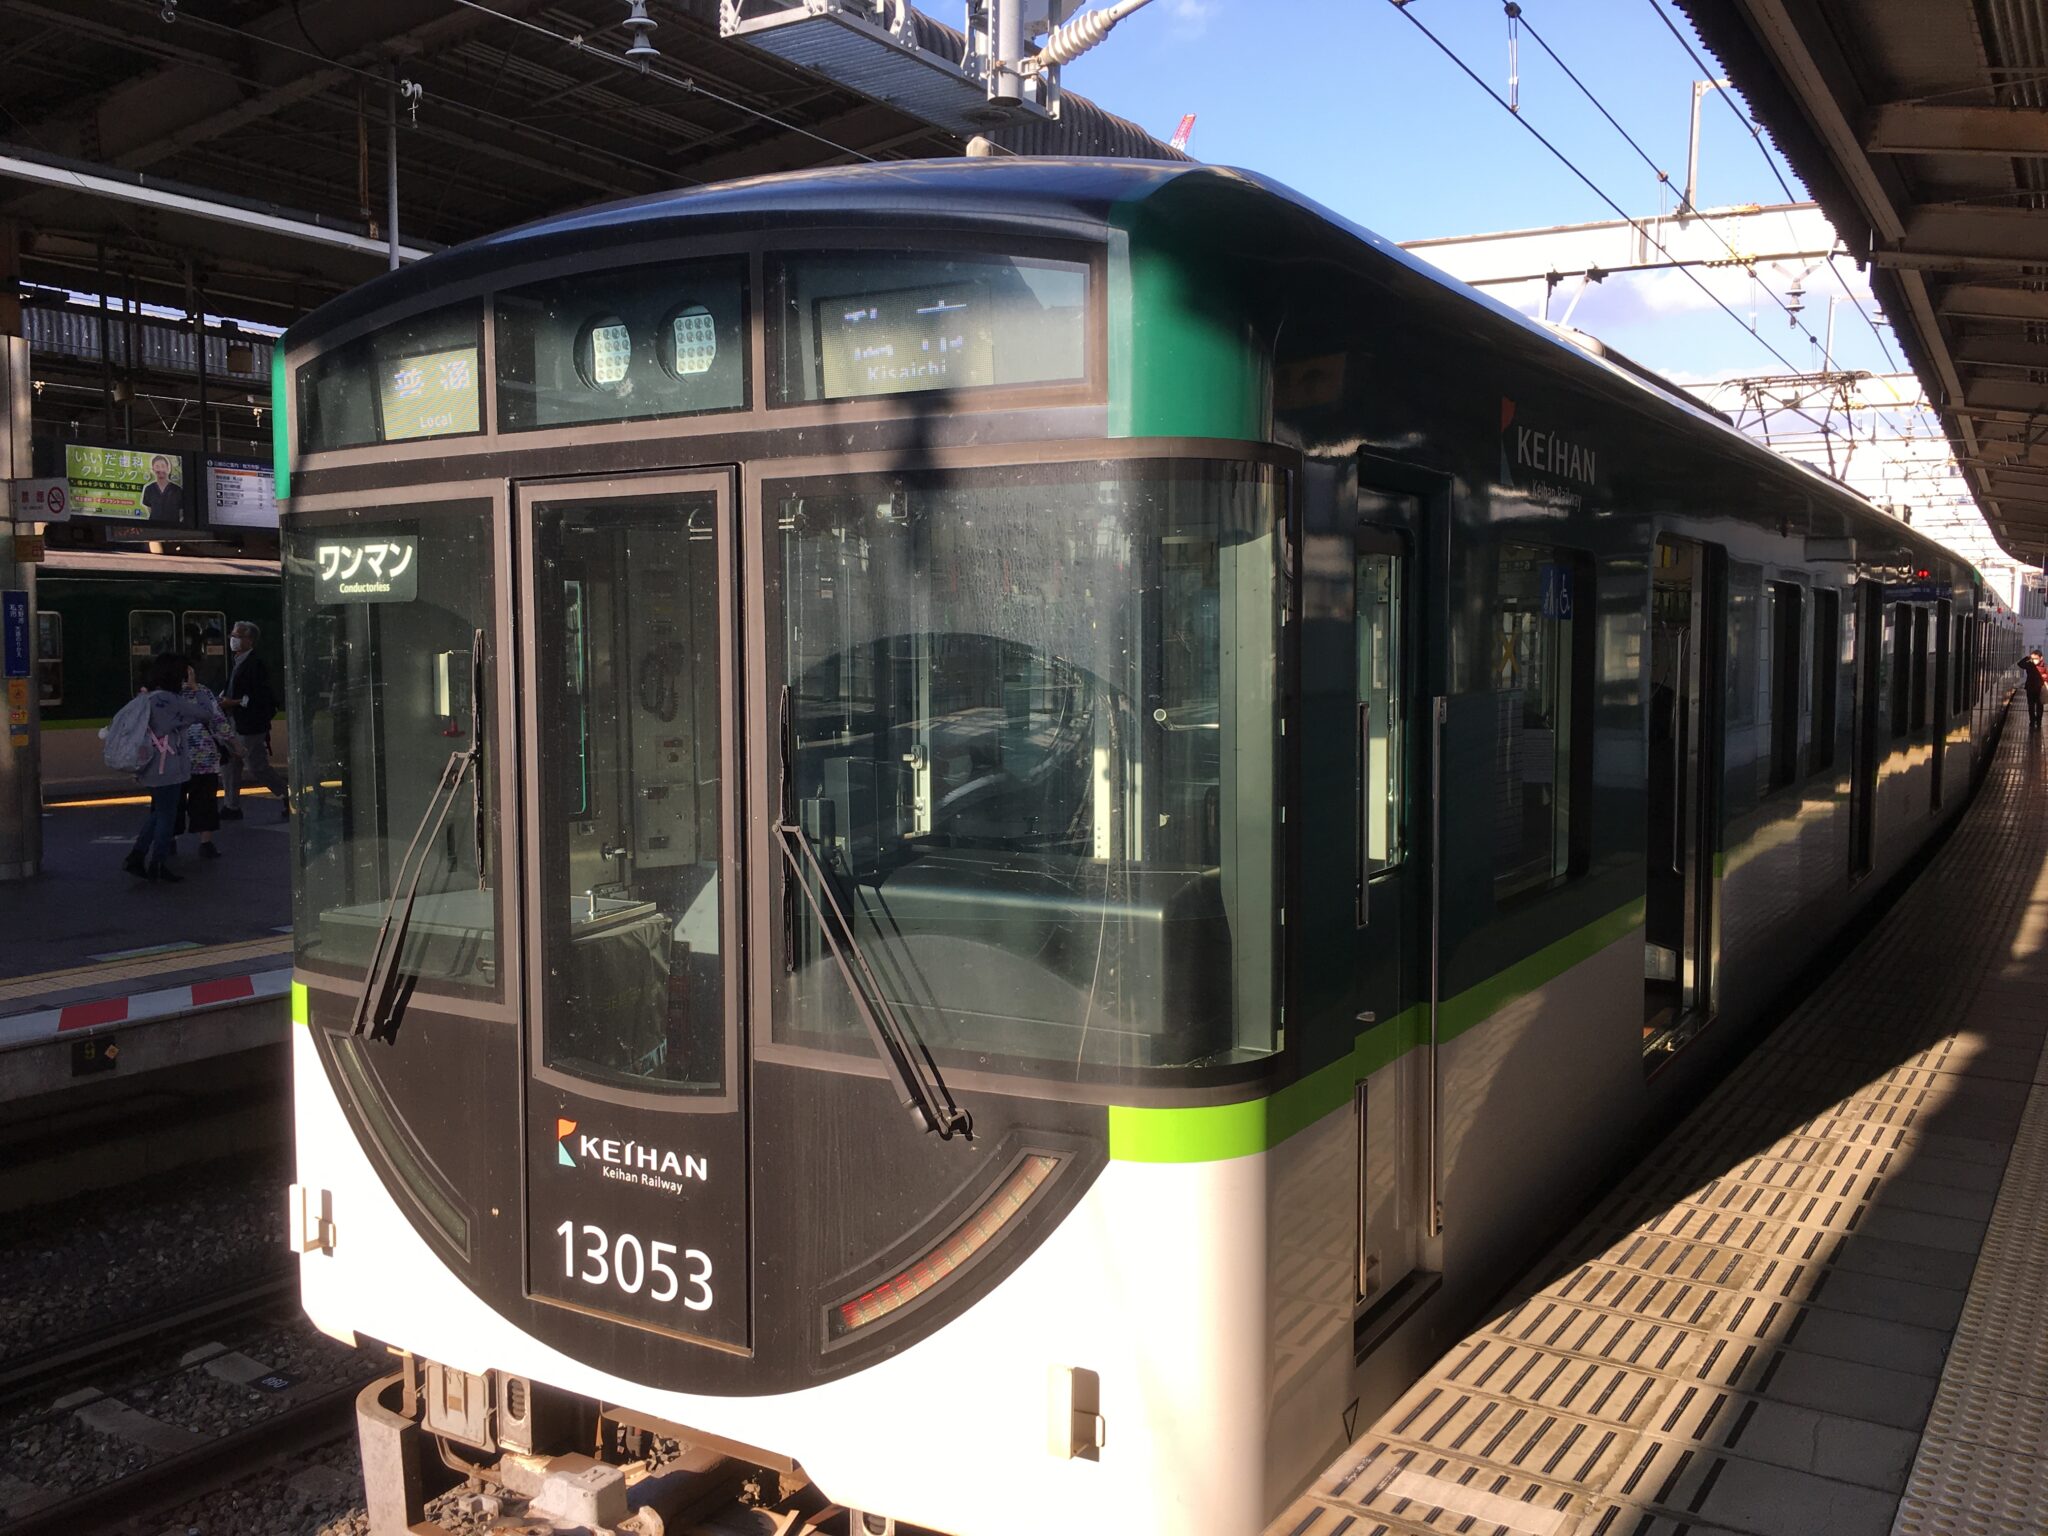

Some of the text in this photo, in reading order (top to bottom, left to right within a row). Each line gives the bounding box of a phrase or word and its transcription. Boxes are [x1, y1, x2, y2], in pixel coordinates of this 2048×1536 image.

[868, 359, 947, 380] Kisaichi
[420, 412, 453, 429] Local
[1517, 425, 1596, 486] KEIHAN
[1532, 480, 1556, 498] Keihan
[319, 543, 413, 581] ワンマン
[339, 582, 391, 593] Conductorless
[580, 1135, 708, 1181] KEIHAN
[602, 1166, 683, 1195] Keihan Railway
[556, 1220, 714, 1312] 13053
